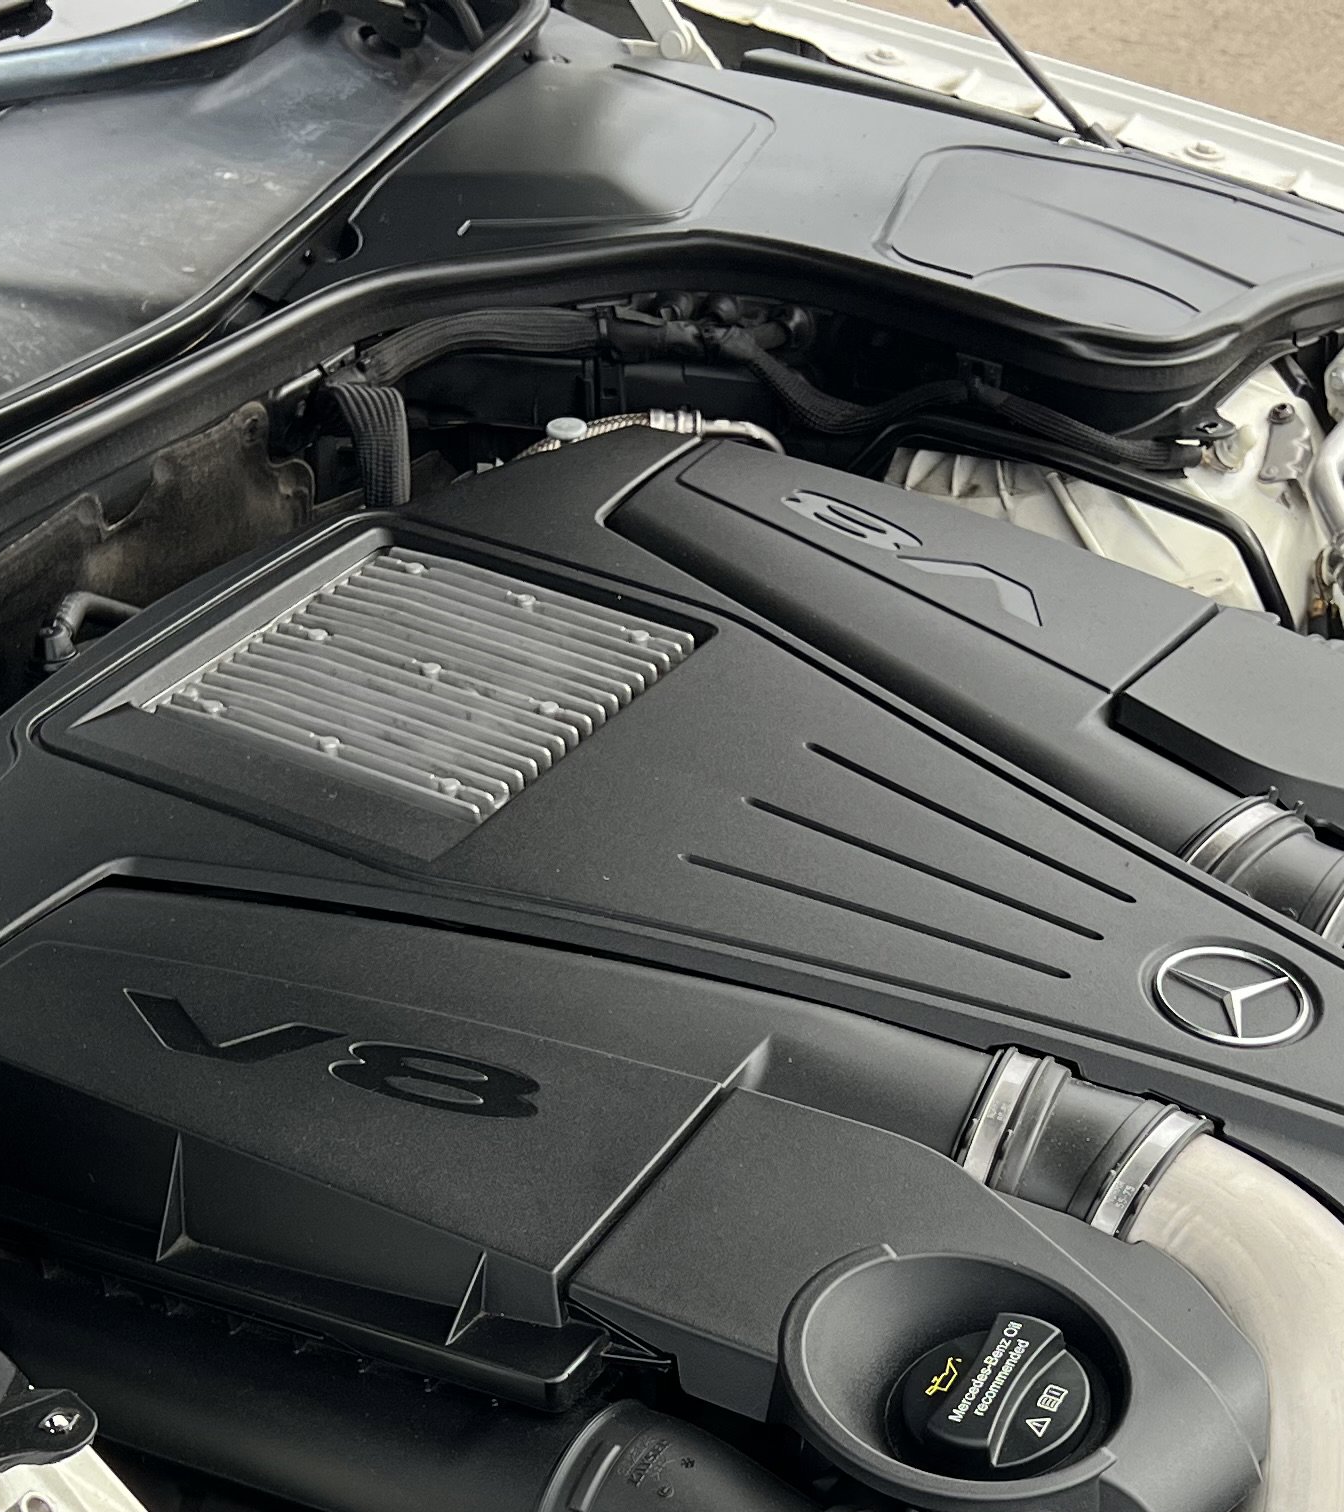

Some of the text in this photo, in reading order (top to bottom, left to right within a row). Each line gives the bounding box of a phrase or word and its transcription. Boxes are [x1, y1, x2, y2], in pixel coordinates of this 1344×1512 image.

[781, 487, 1043, 627] V8
[122, 986, 541, 1119] V8
[948, 1321, 1024, 1422] Mercedes-Benz Oil
[973, 1339, 1029, 1416] recommended
